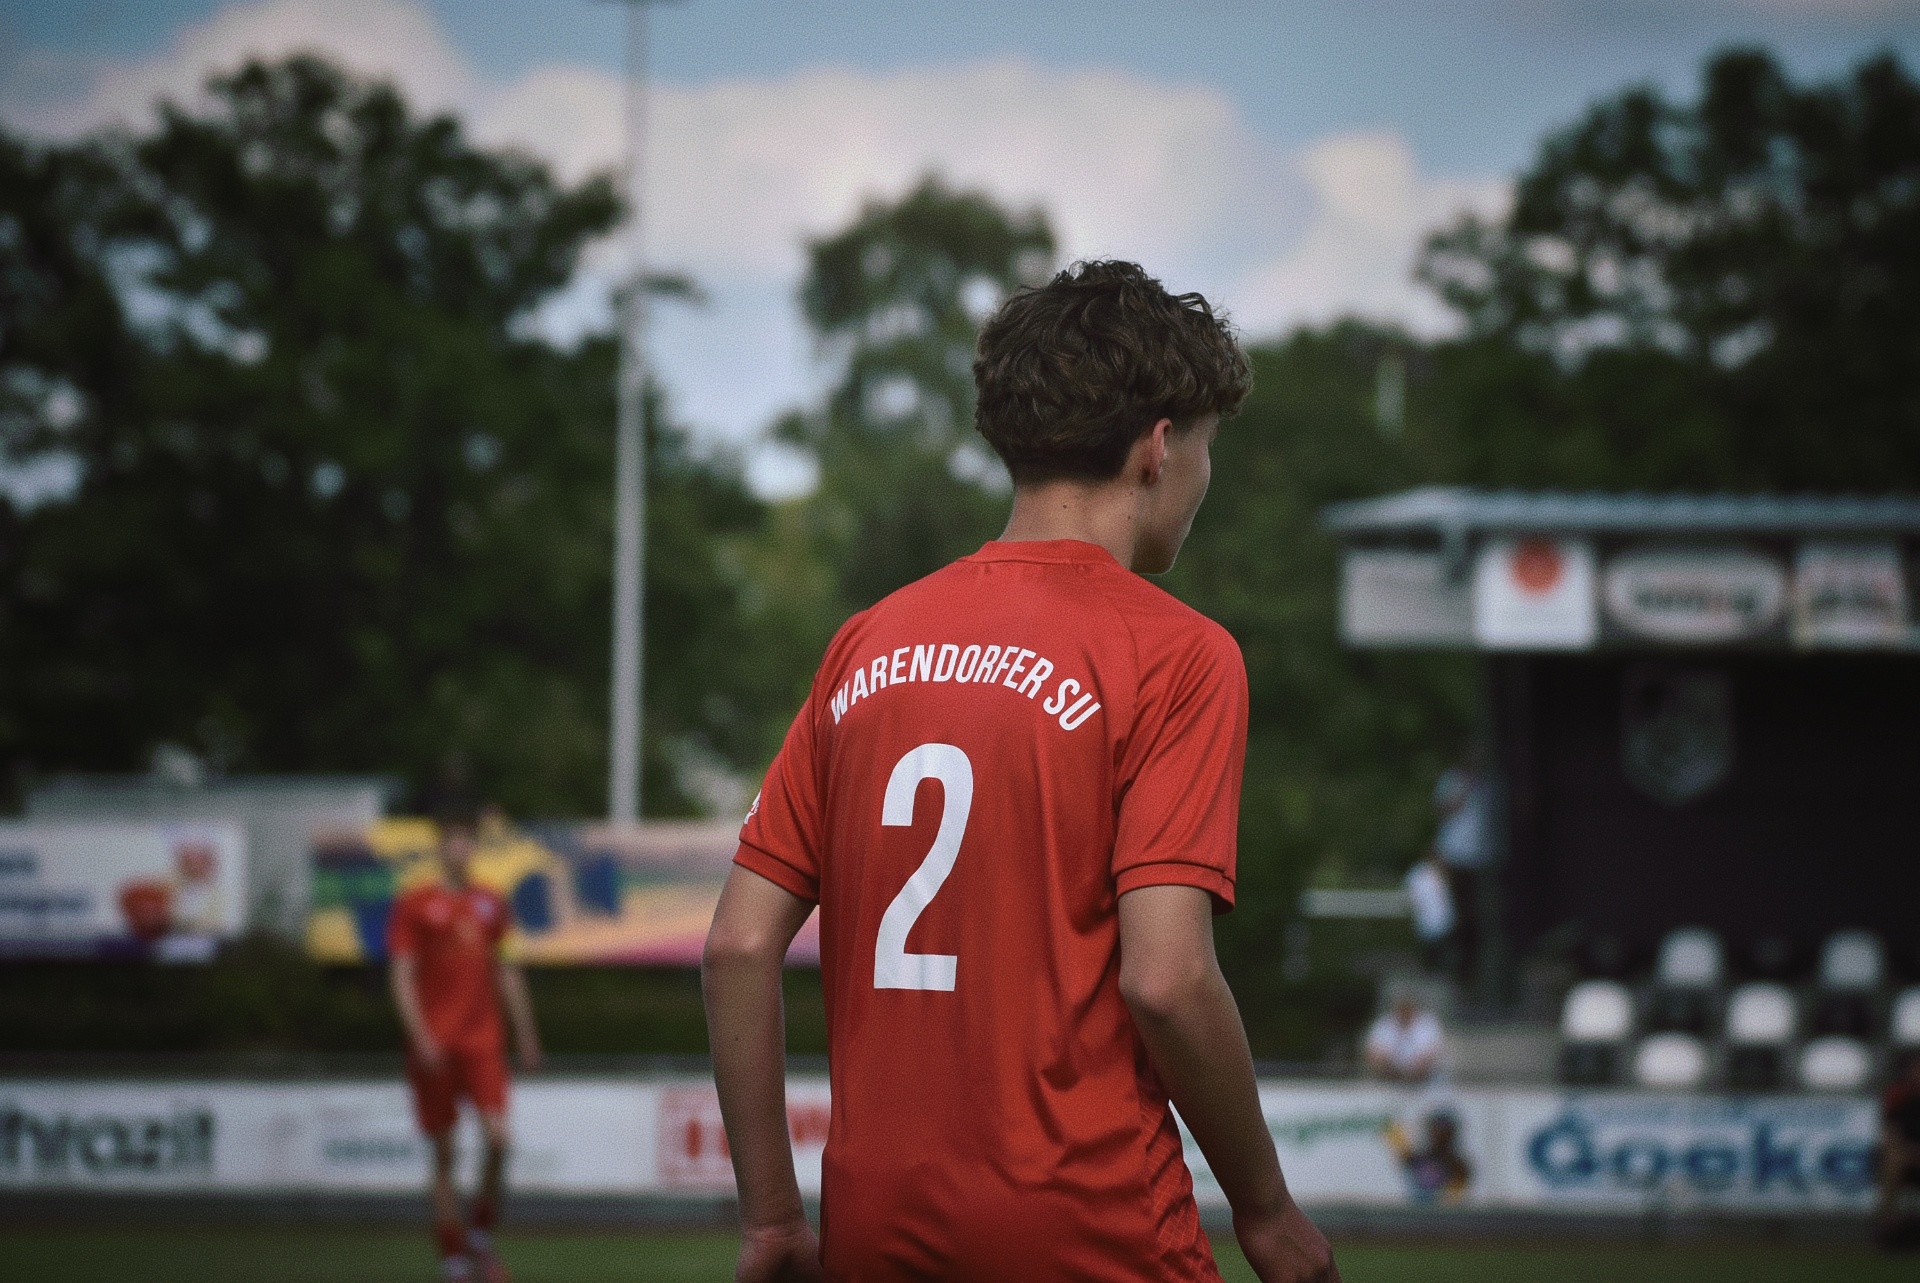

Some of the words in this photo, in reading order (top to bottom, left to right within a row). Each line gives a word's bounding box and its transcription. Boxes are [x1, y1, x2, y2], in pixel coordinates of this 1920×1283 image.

[830, 643, 1054, 726] WARENDORFER
[1042, 678, 1102, 731] SU
[873, 742, 974, 992] 2
